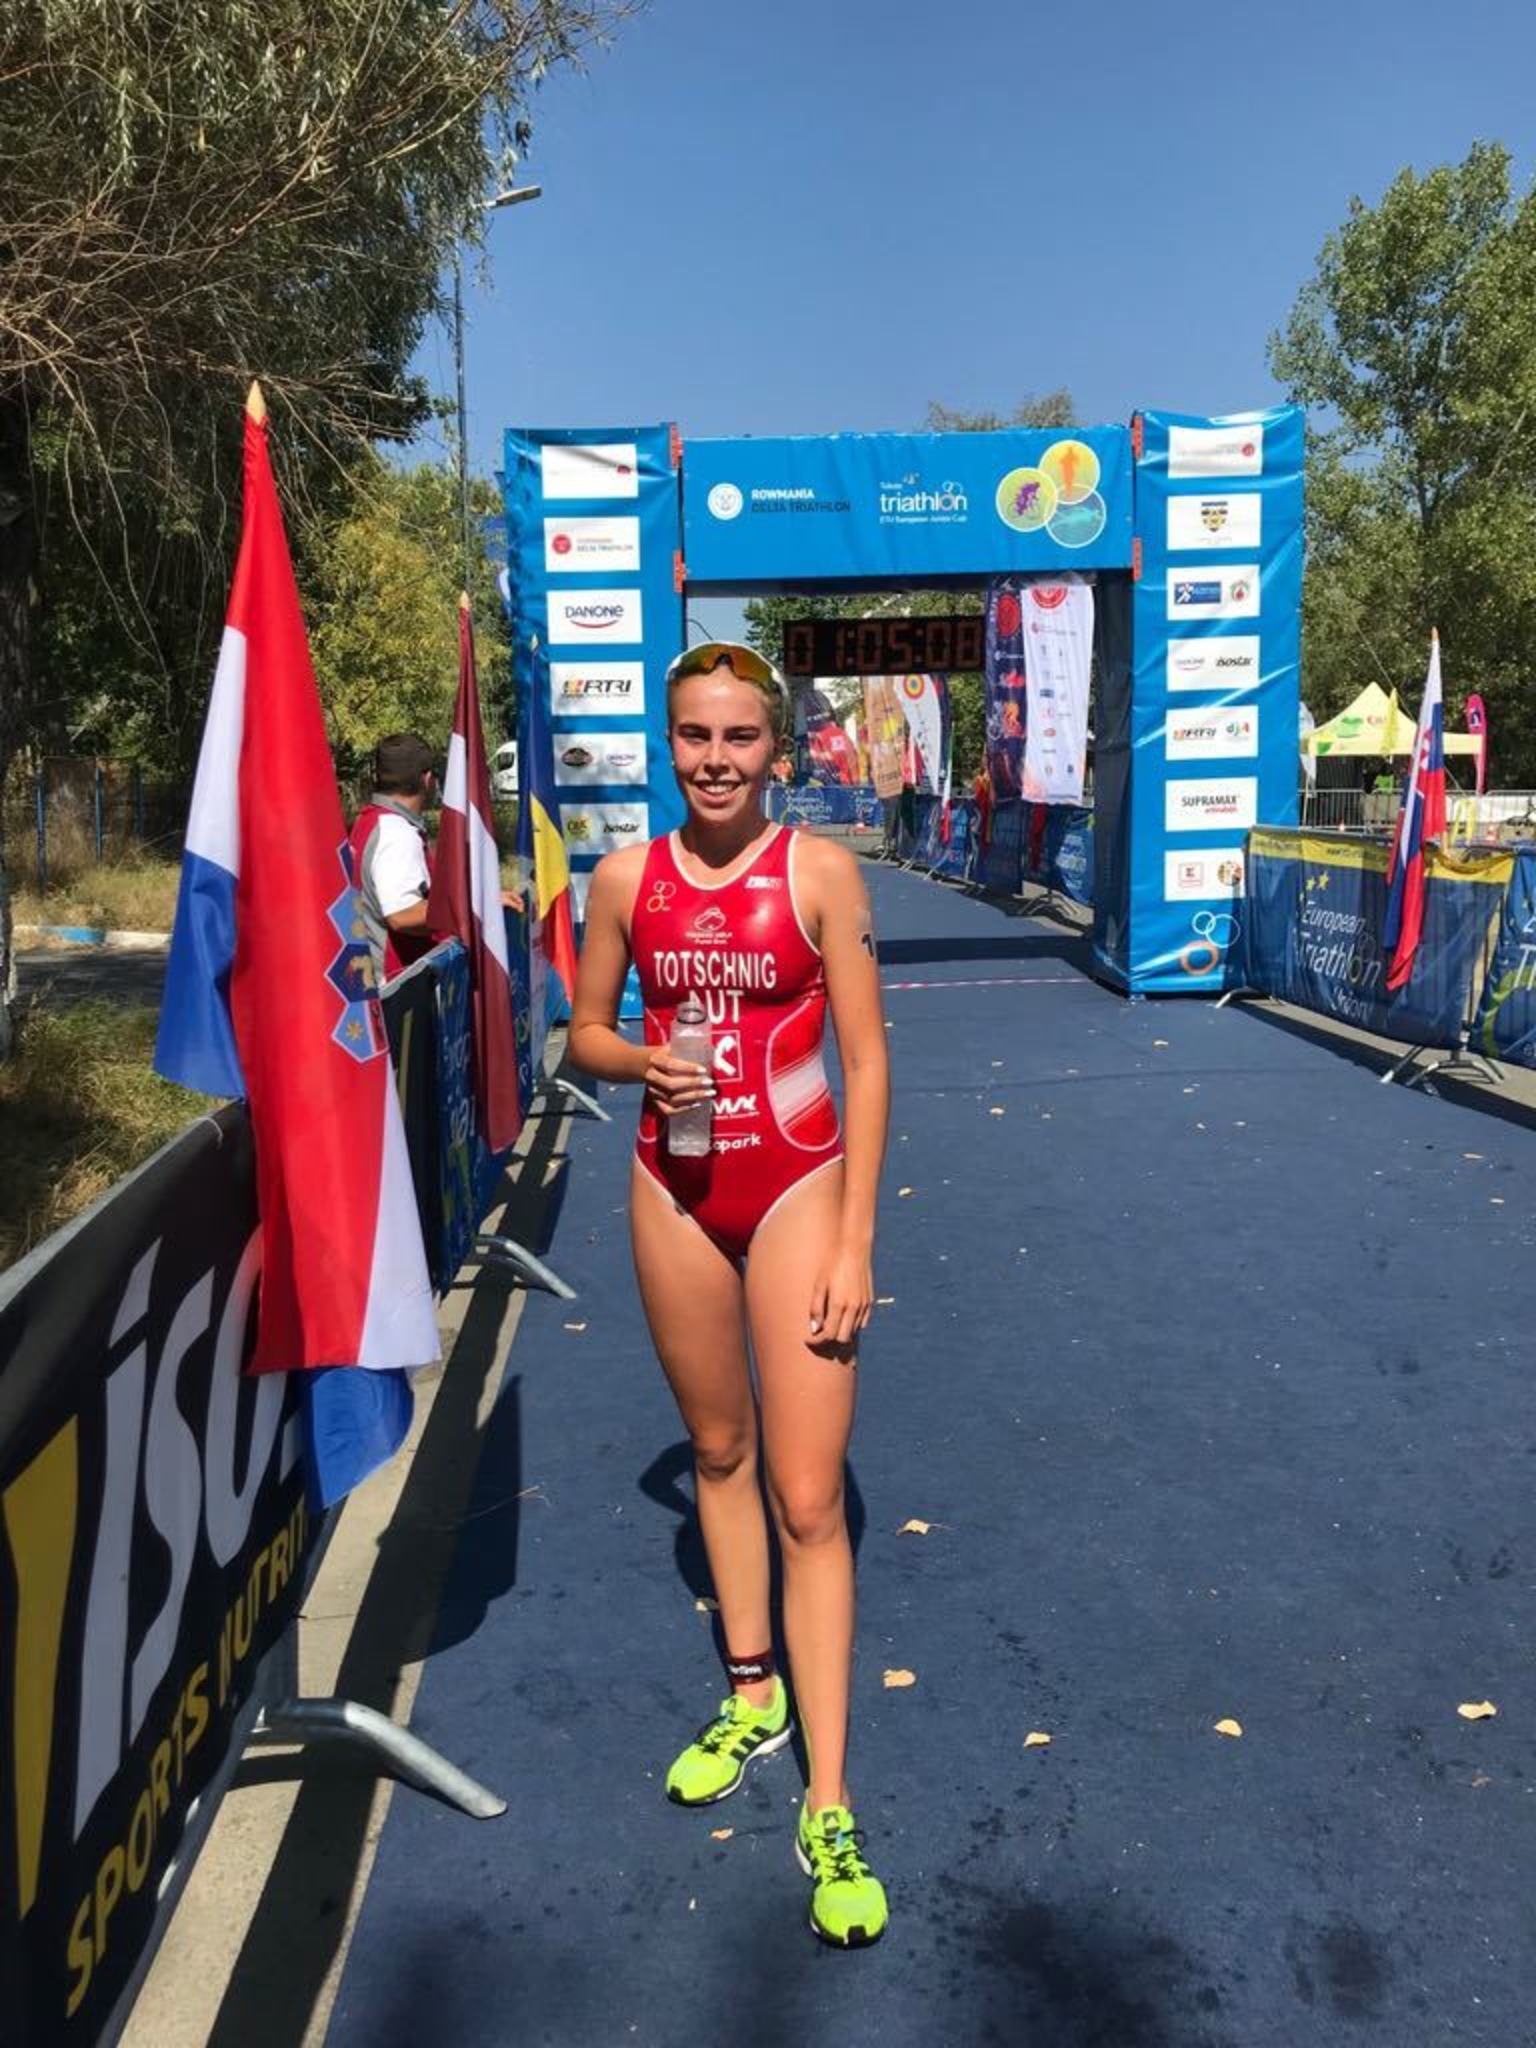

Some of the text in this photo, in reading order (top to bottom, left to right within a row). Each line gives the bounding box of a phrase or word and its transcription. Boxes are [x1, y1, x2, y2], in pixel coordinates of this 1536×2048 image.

[751, 488, 815, 500] ROWMANIA
[880, 491, 967, 512] triathlon
[565, 605, 624, 618] DANONE
[1181, 795, 1237, 807] SUPRAMAX
[1301, 900, 1367, 935] European
[653, 950, 777, 989] TOTSCHNIG
[1300, 931, 1382, 989] Triathlon
[72, 1235, 303, 1843] iso
[66, 1660, 209, 2019] SPORTS
